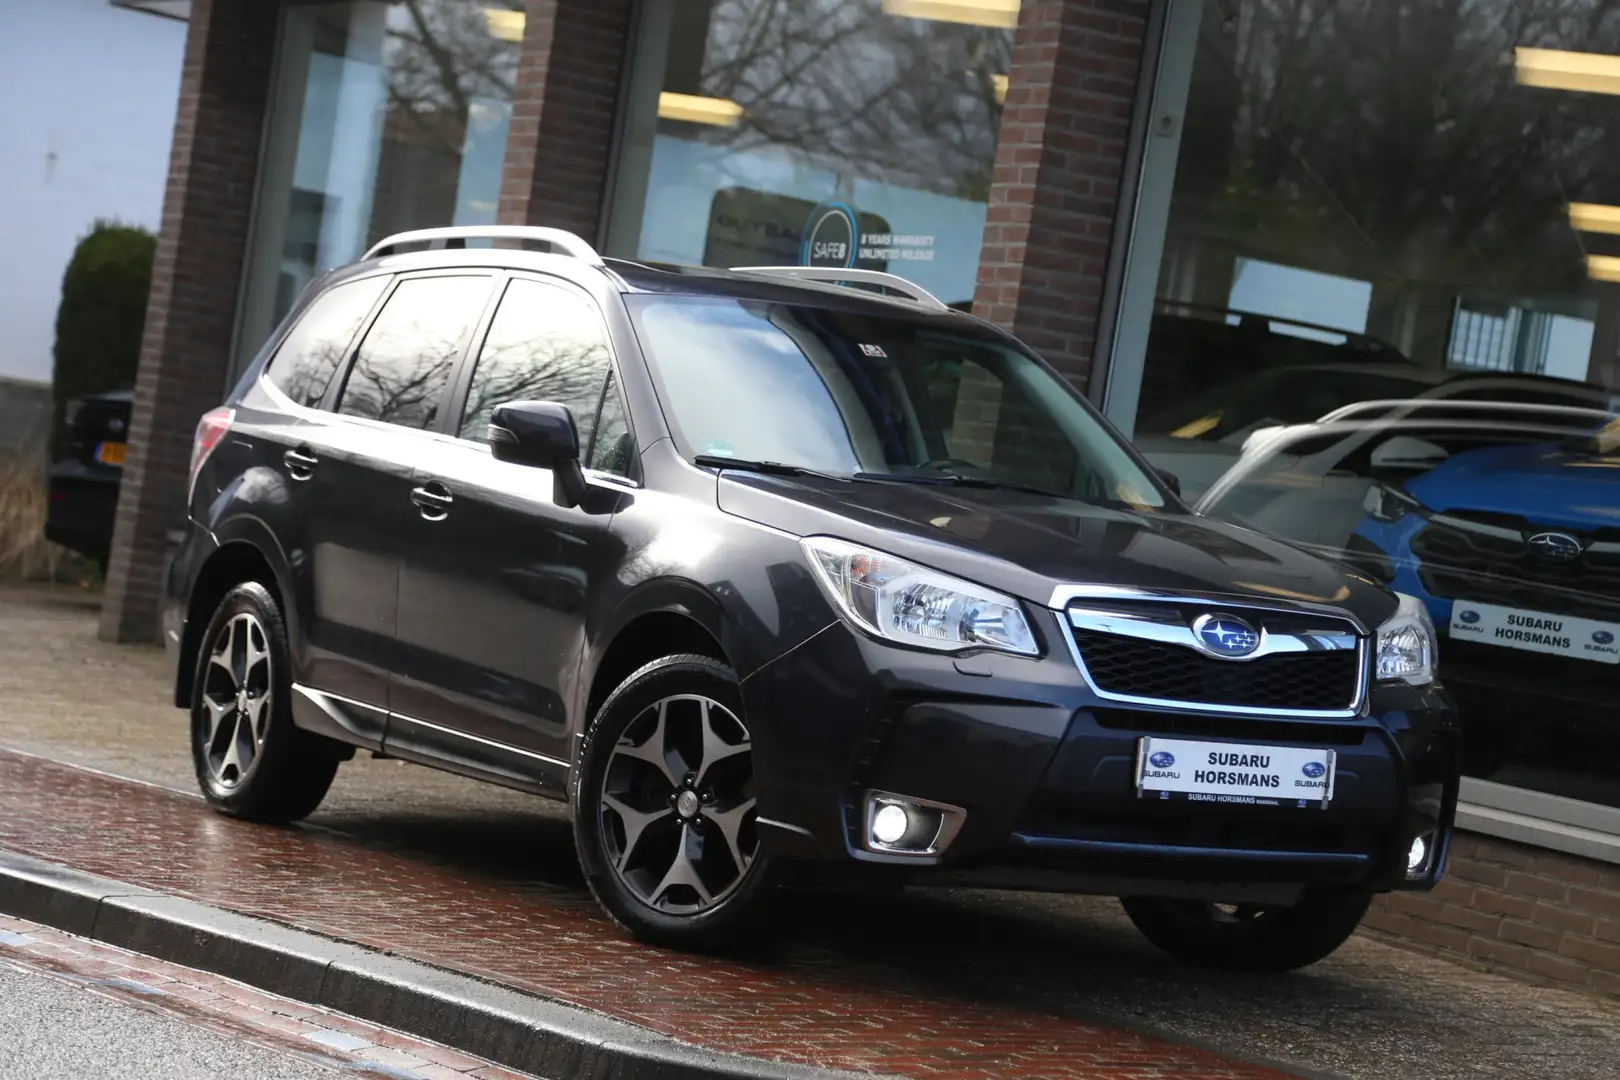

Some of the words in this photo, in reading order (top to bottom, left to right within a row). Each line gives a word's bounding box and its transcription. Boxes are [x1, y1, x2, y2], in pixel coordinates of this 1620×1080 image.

[868, 233, 891, 245] YEARS
[1453, 623, 1484, 633] SUBARU
[1508, 614, 1563, 632] SUBARU
[1494, 627, 1571, 648] HORSMANS
[1584, 644, 1618, 654] SUBARU
[1208, 752, 1270, 768] SUBARU
[1143, 770, 1180, 779] SUBARU
[1194, 770, 1280, 788] HORSMANS
[1188, 793, 1216, 801] SUBARU
[1217, 796, 1255, 804] HORSMANS
